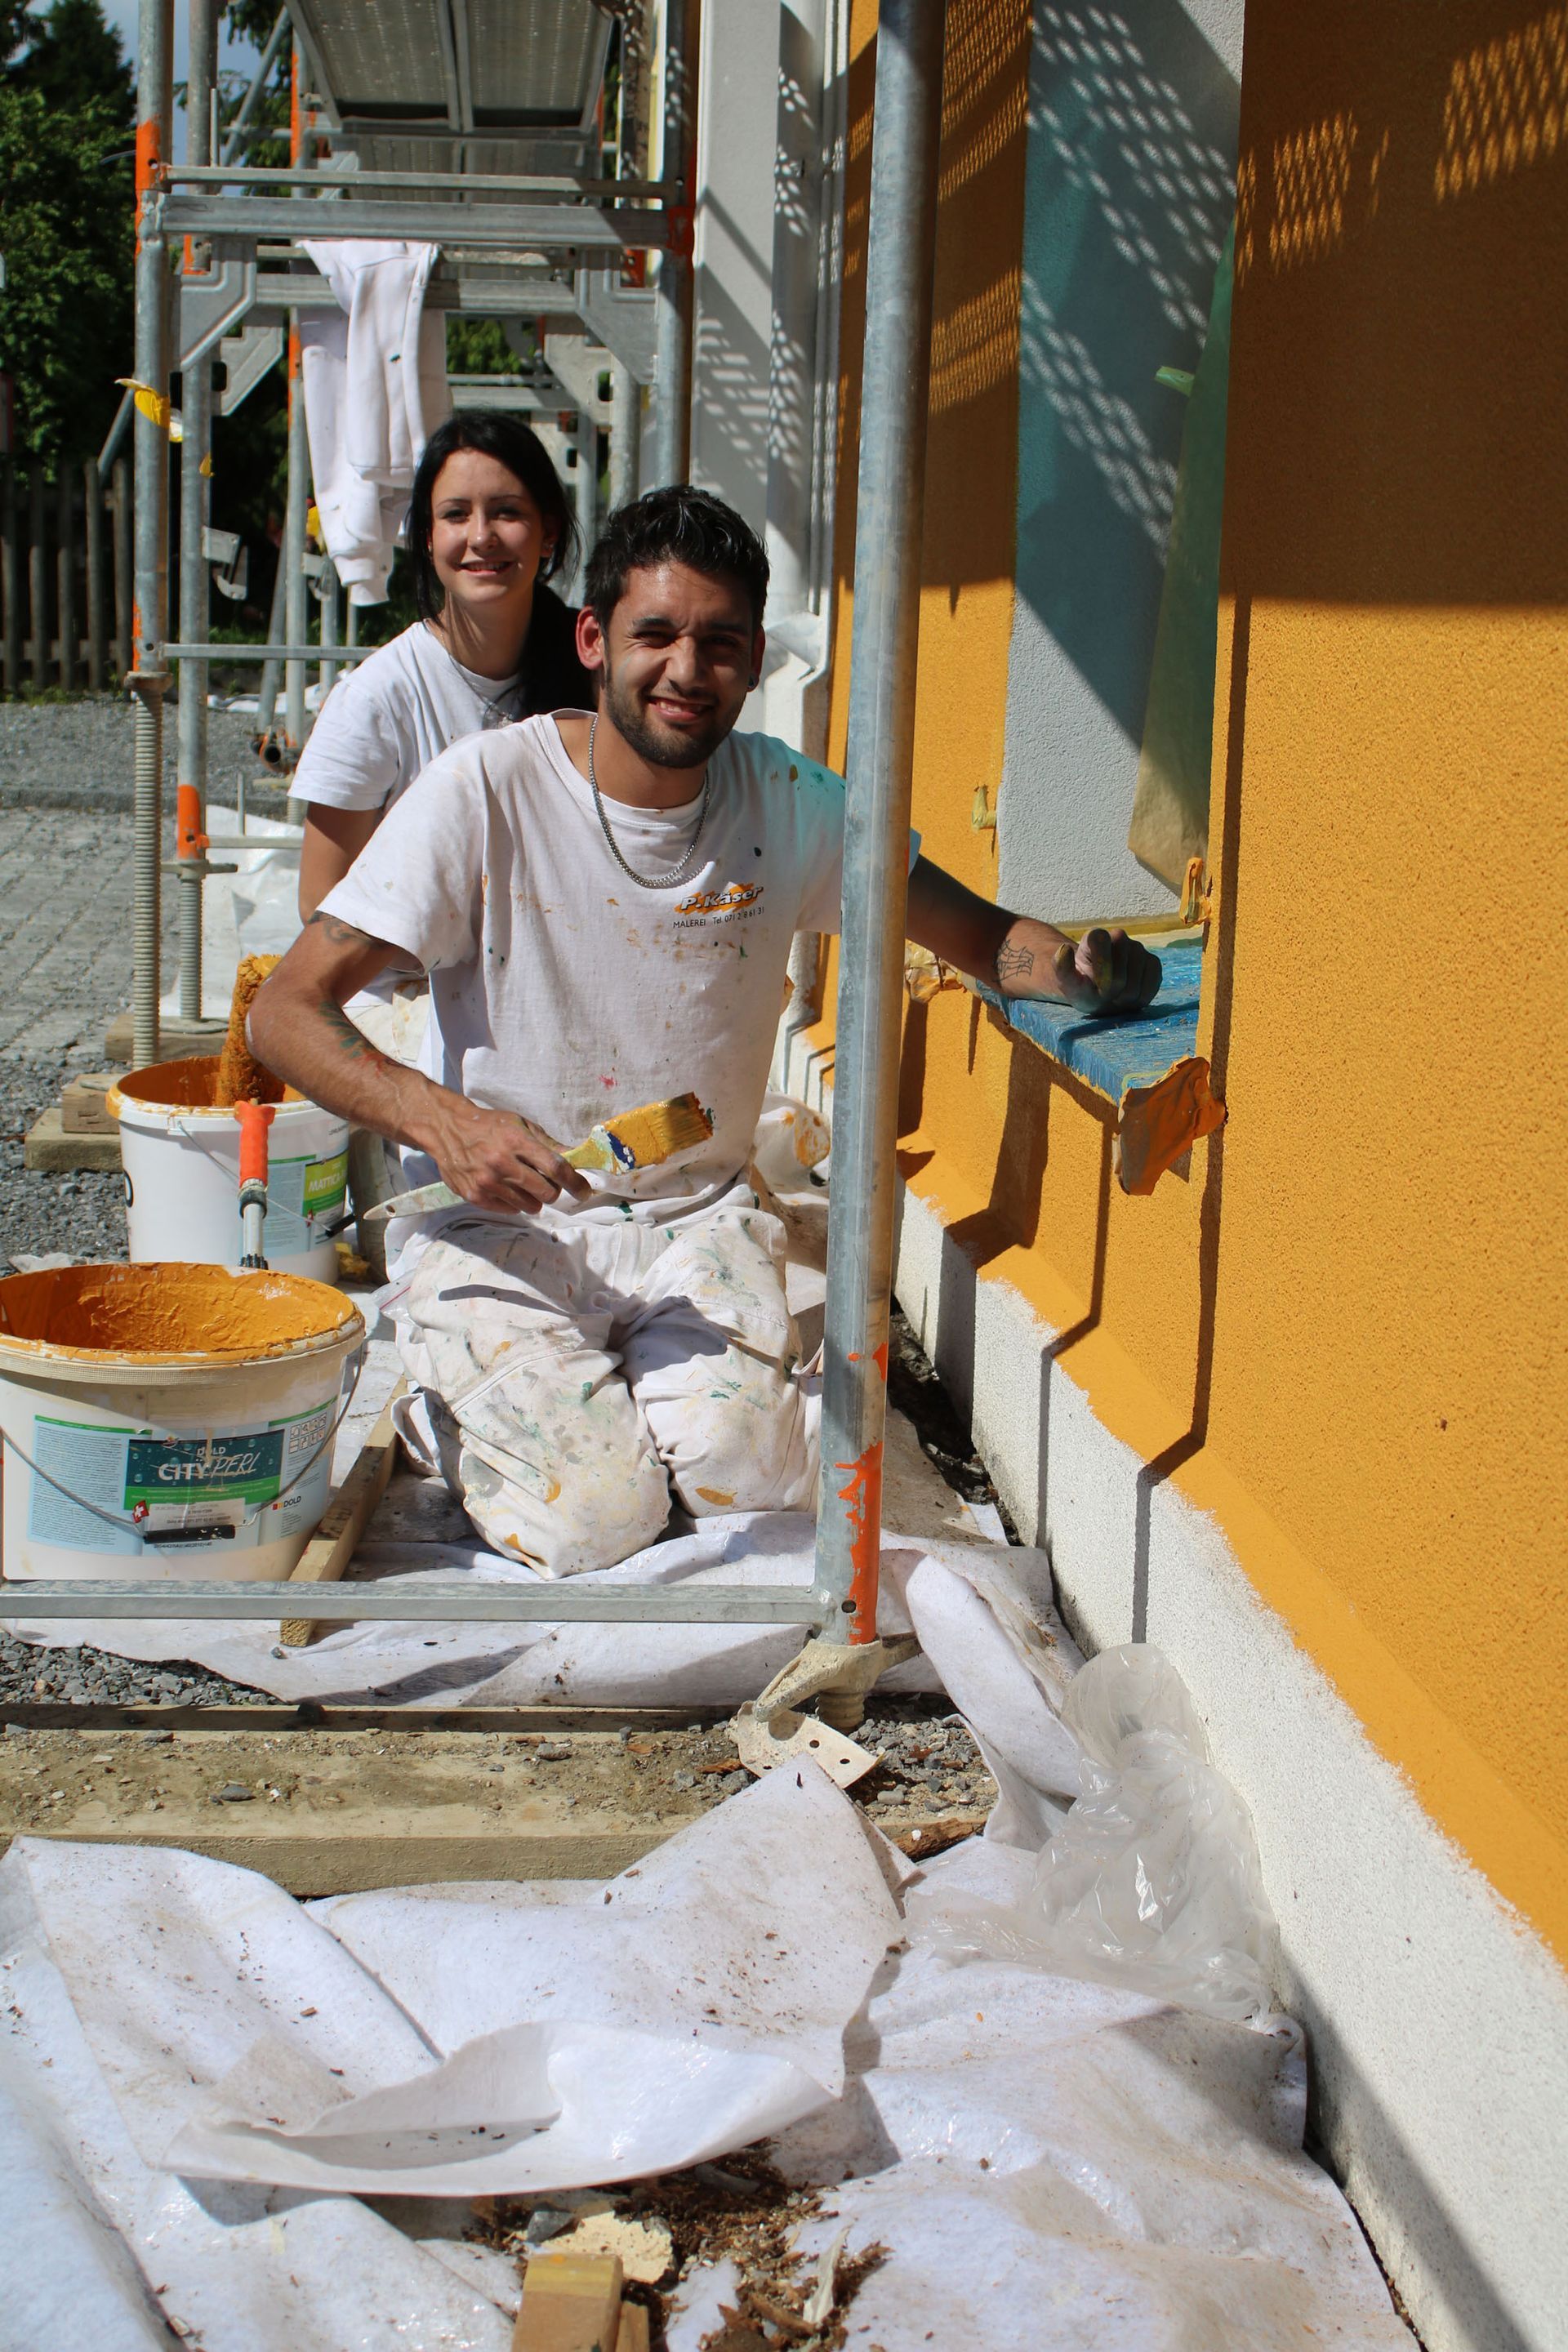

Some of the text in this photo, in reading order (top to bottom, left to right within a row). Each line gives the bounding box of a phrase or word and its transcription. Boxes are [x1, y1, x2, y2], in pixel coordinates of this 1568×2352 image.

[680, 886, 764, 910] P.Käser
[673, 919, 706, 929] MALEREI
[724, 914, 735, 923] 071
[196, 1446, 226, 1456] DLD
[283, 1495, 301, 1508] DOLD
